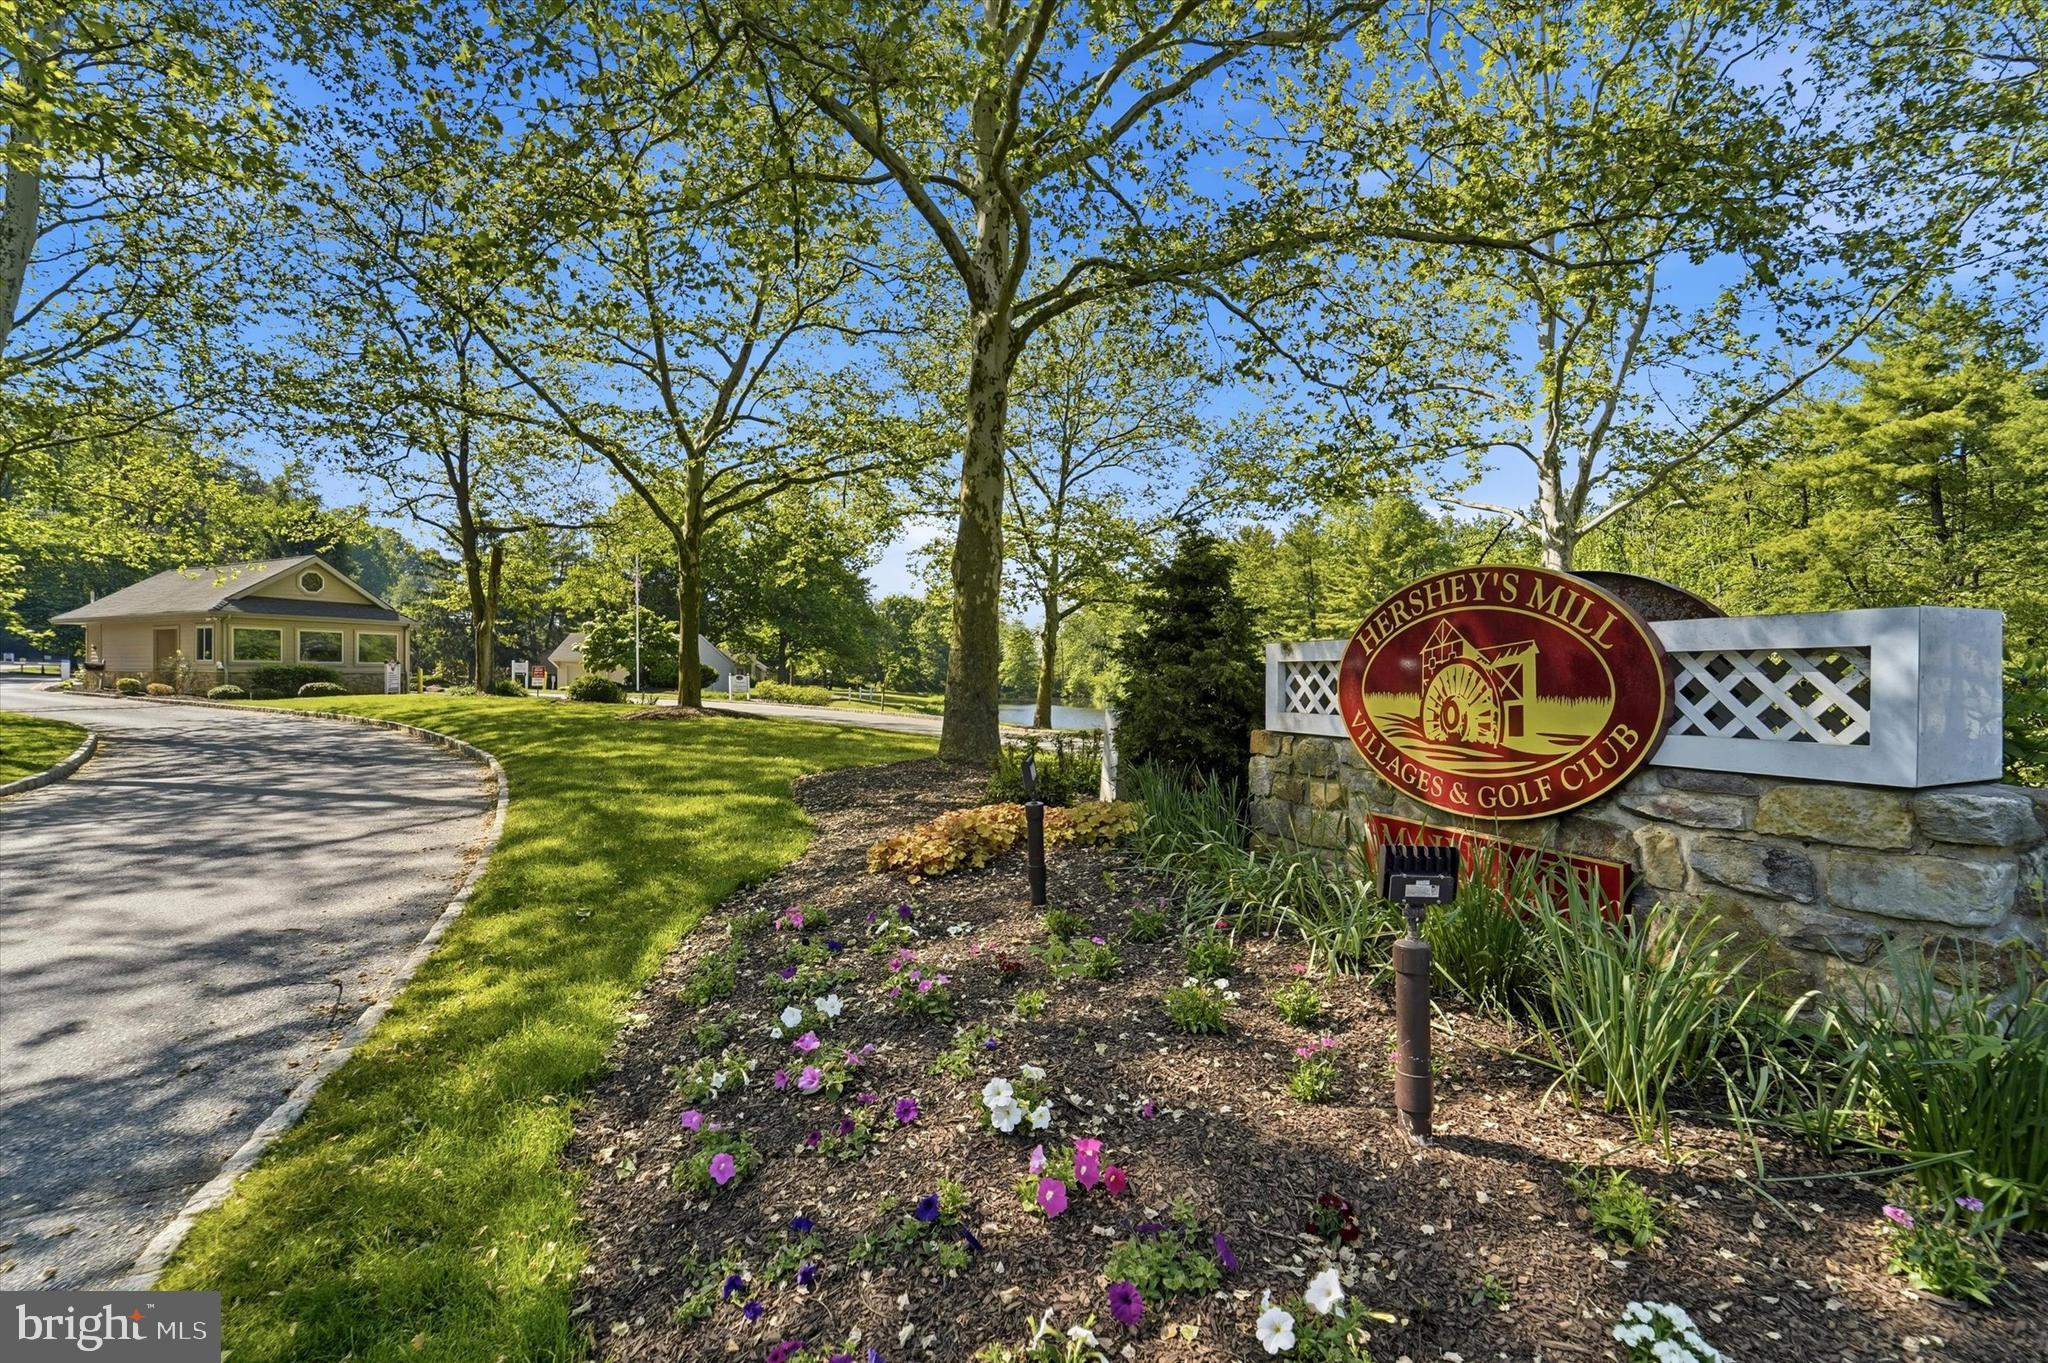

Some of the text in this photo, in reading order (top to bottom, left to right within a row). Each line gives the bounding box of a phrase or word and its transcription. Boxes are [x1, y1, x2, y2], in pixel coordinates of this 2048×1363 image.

[1355, 572, 1618, 656] HERSHEY'S MILL
[1351, 709, 1640, 809] VILLAGES & GOLF CLUB
